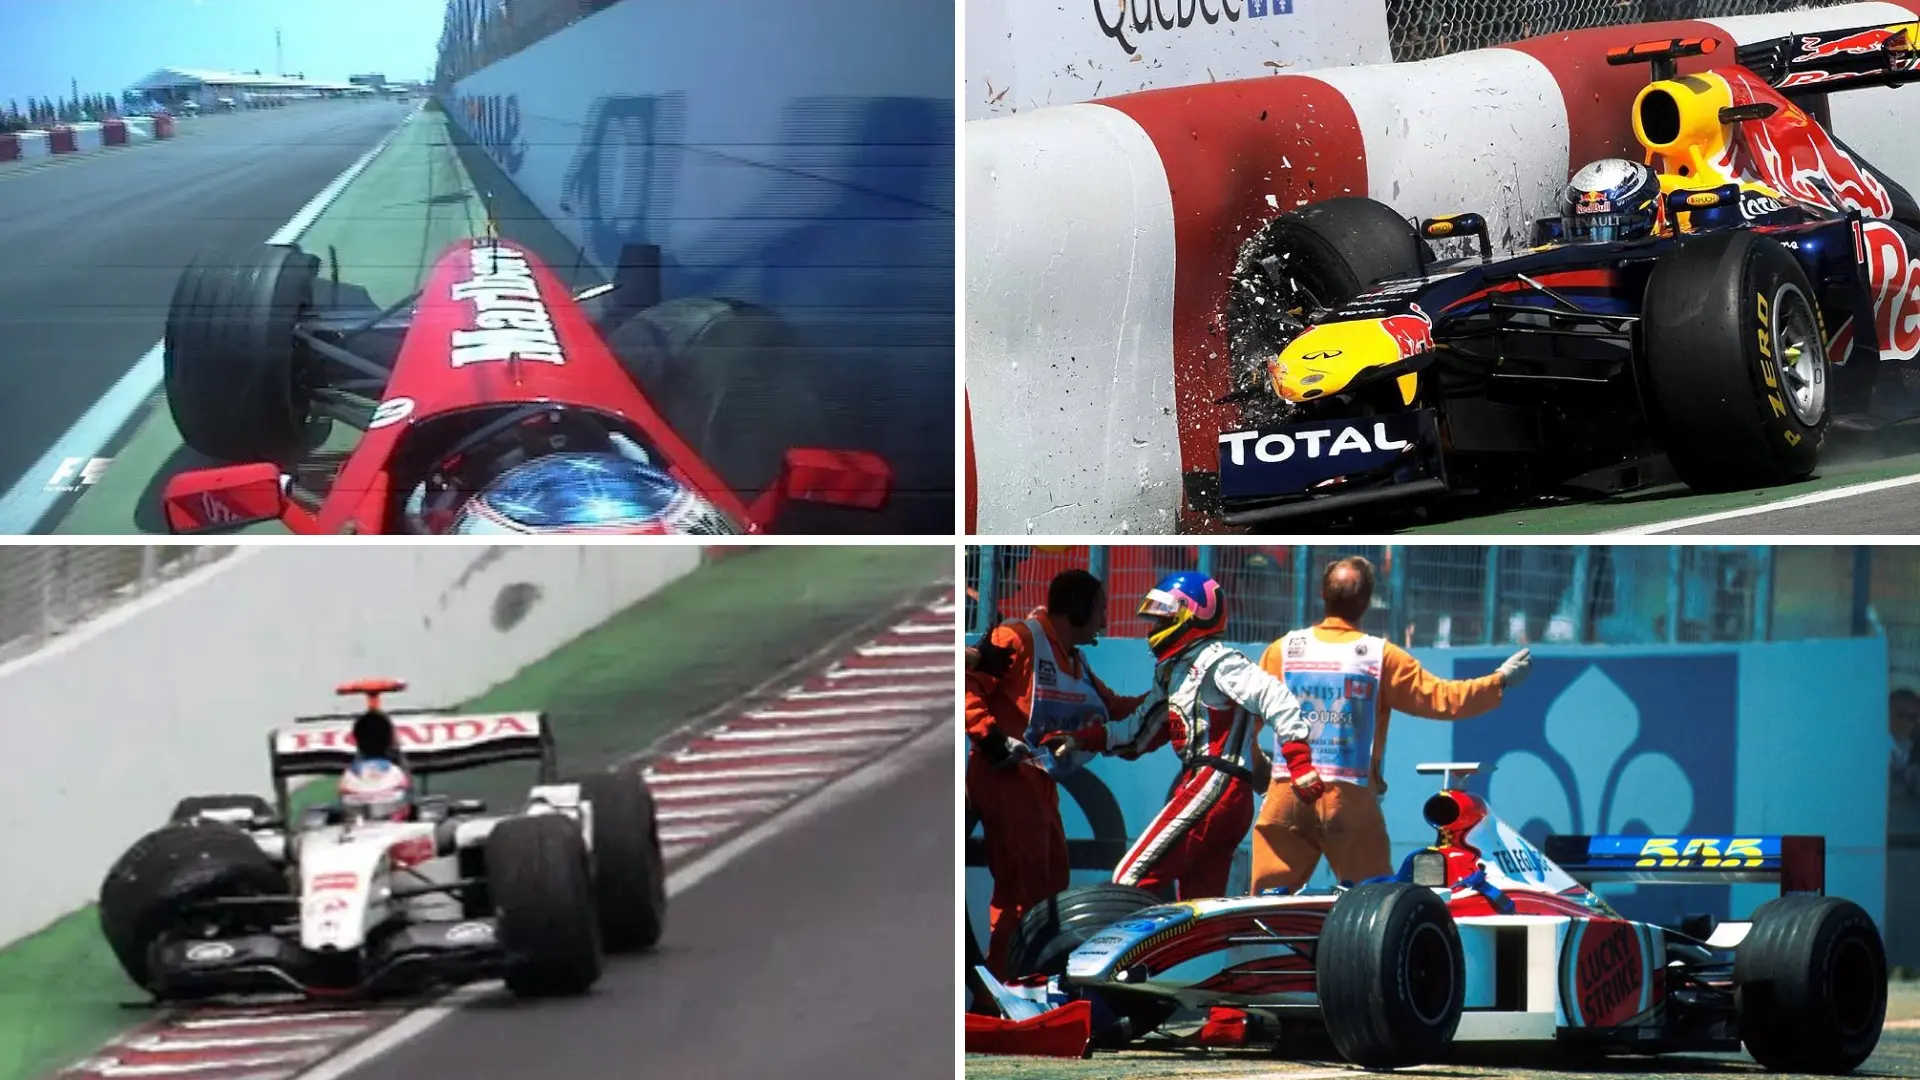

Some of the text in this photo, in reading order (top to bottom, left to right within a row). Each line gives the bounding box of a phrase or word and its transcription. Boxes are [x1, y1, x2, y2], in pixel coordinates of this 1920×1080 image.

[1852, 220, 1864, 264] 1
[1757, 292, 1787, 419] ZERO
[1218, 422, 1407, 466] TOTAL
[293, 716, 528, 749] HNDA
[1635, 838, 1765, 868] 555
[1580, 922, 1631, 989] LUCKY
[1583, 957, 1640, 1027] STRIKE
